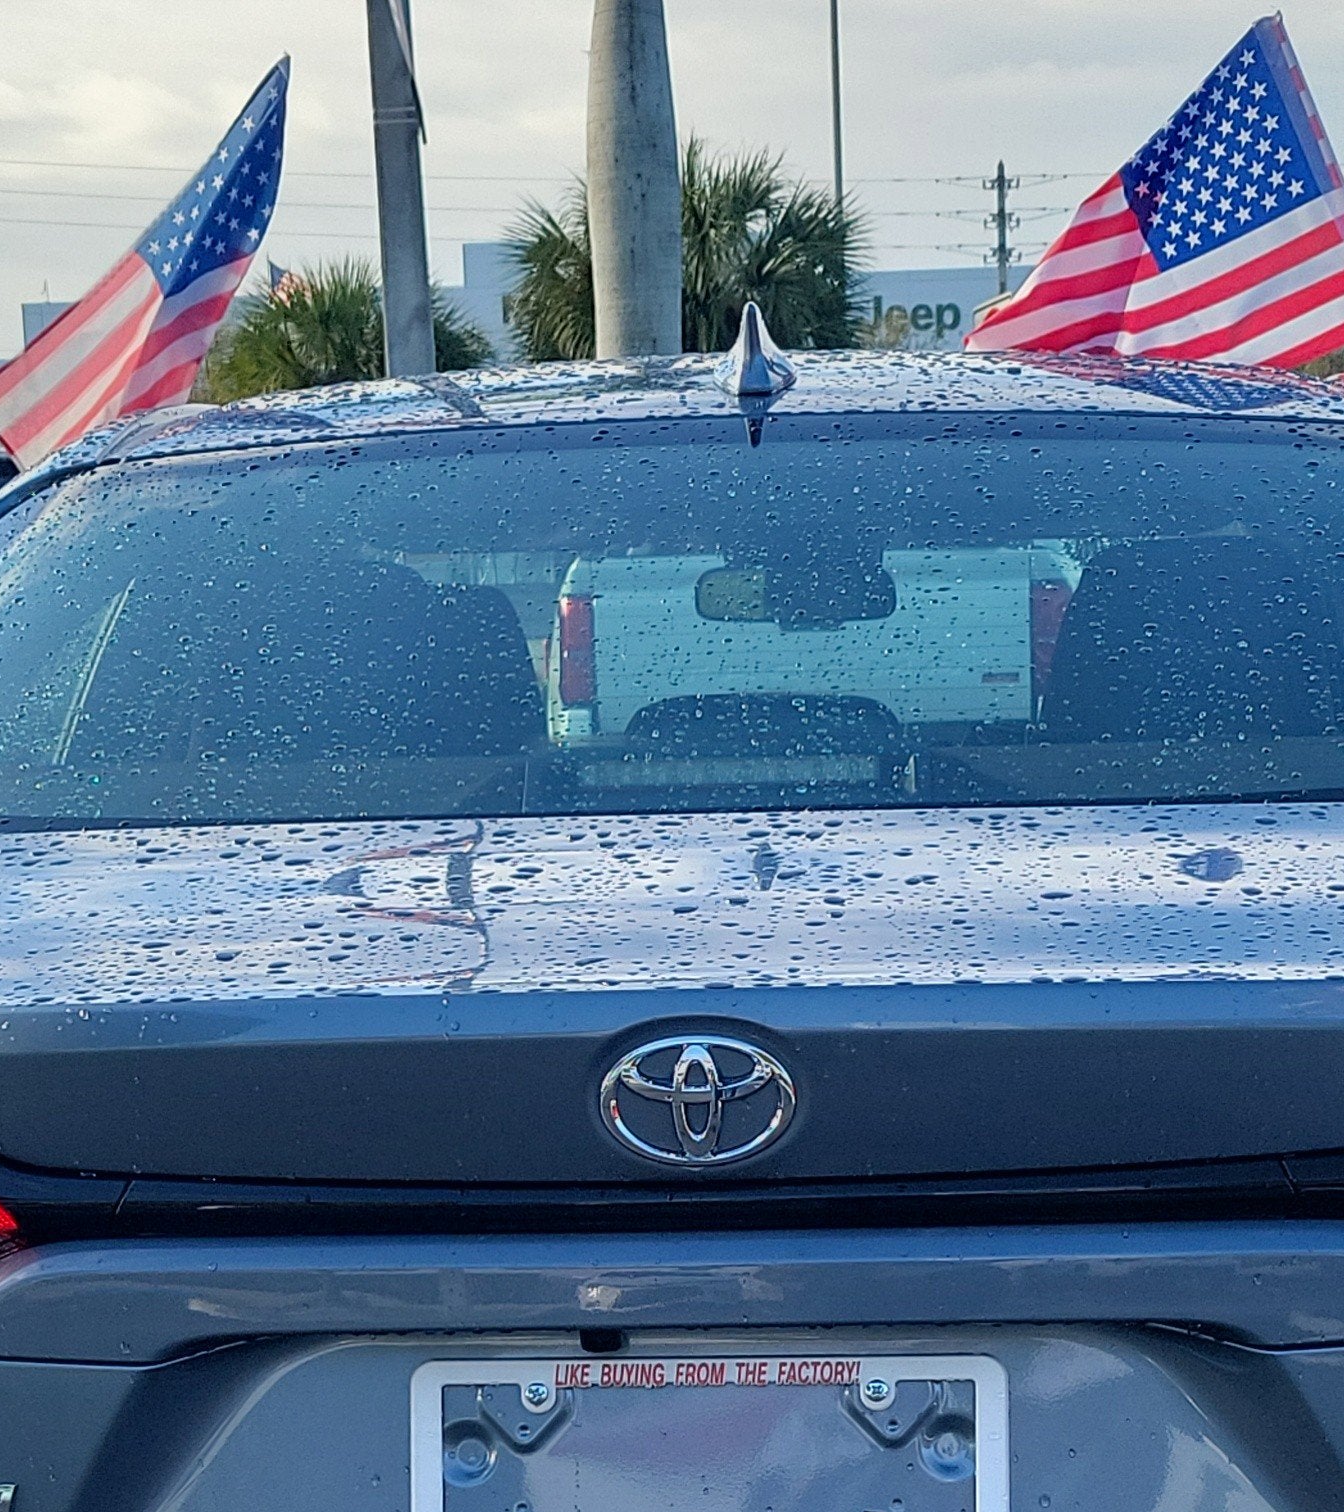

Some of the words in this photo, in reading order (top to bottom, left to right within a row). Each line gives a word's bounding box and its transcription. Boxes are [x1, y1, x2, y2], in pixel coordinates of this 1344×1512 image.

[872, 294, 962, 339] Jeep
[555, 1363, 590, 1386] LIKE
[600, 1362, 665, 1387] BUYING
[675, 1362, 726, 1386] FROM
[736, 1361, 769, 1385] THE
[777, 1360, 862, 1385] FACTORY!
